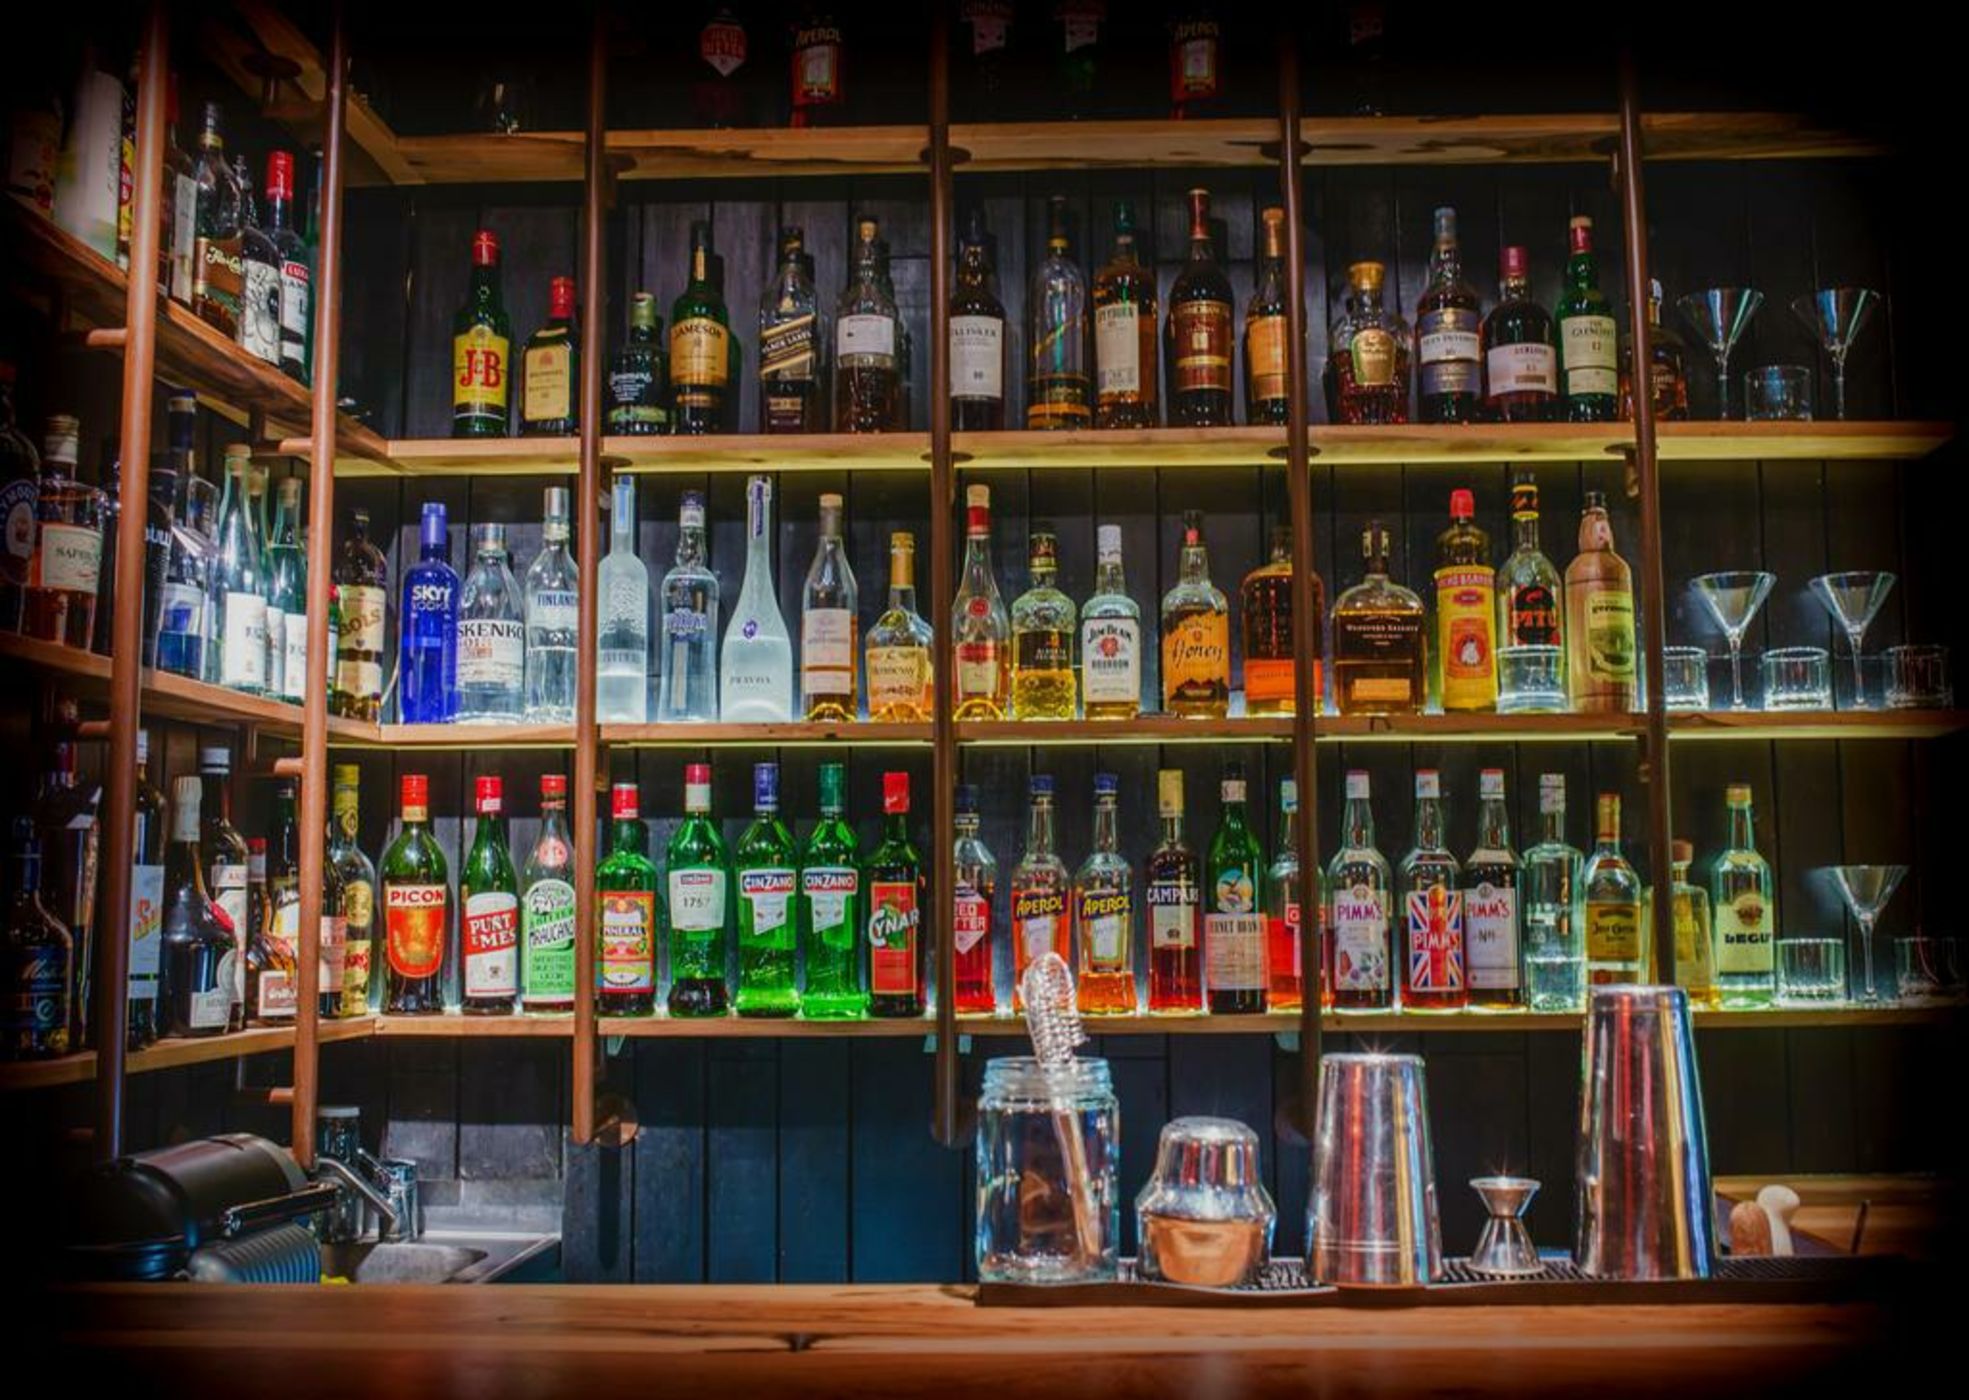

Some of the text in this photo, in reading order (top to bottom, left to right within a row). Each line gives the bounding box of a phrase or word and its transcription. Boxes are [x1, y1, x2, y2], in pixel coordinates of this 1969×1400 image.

[674, 324, 723, 340] JAMESON
[412, 583, 452, 602] SKYY
[1086, 624, 1132, 644] JIM BEAM
[743, 876, 794, 889] CINZANO
[804, 875, 856, 889] CINZANO
[390, 889, 443, 902] PICON
[1147, 887, 1199, 903] CAMPARI
[1017, 895, 1064, 915] APEROL
[1083, 895, 1130, 916] APEROL
[1337, 902, 1383, 921] PIMM'S
[1466, 899, 1511, 919] PIMM'S
[470, 913, 511, 935] PUNT
[868, 907, 920, 948] CYNAR
[480, 929, 516, 949] MES
[1413, 932, 1460, 950] PIMM'S
